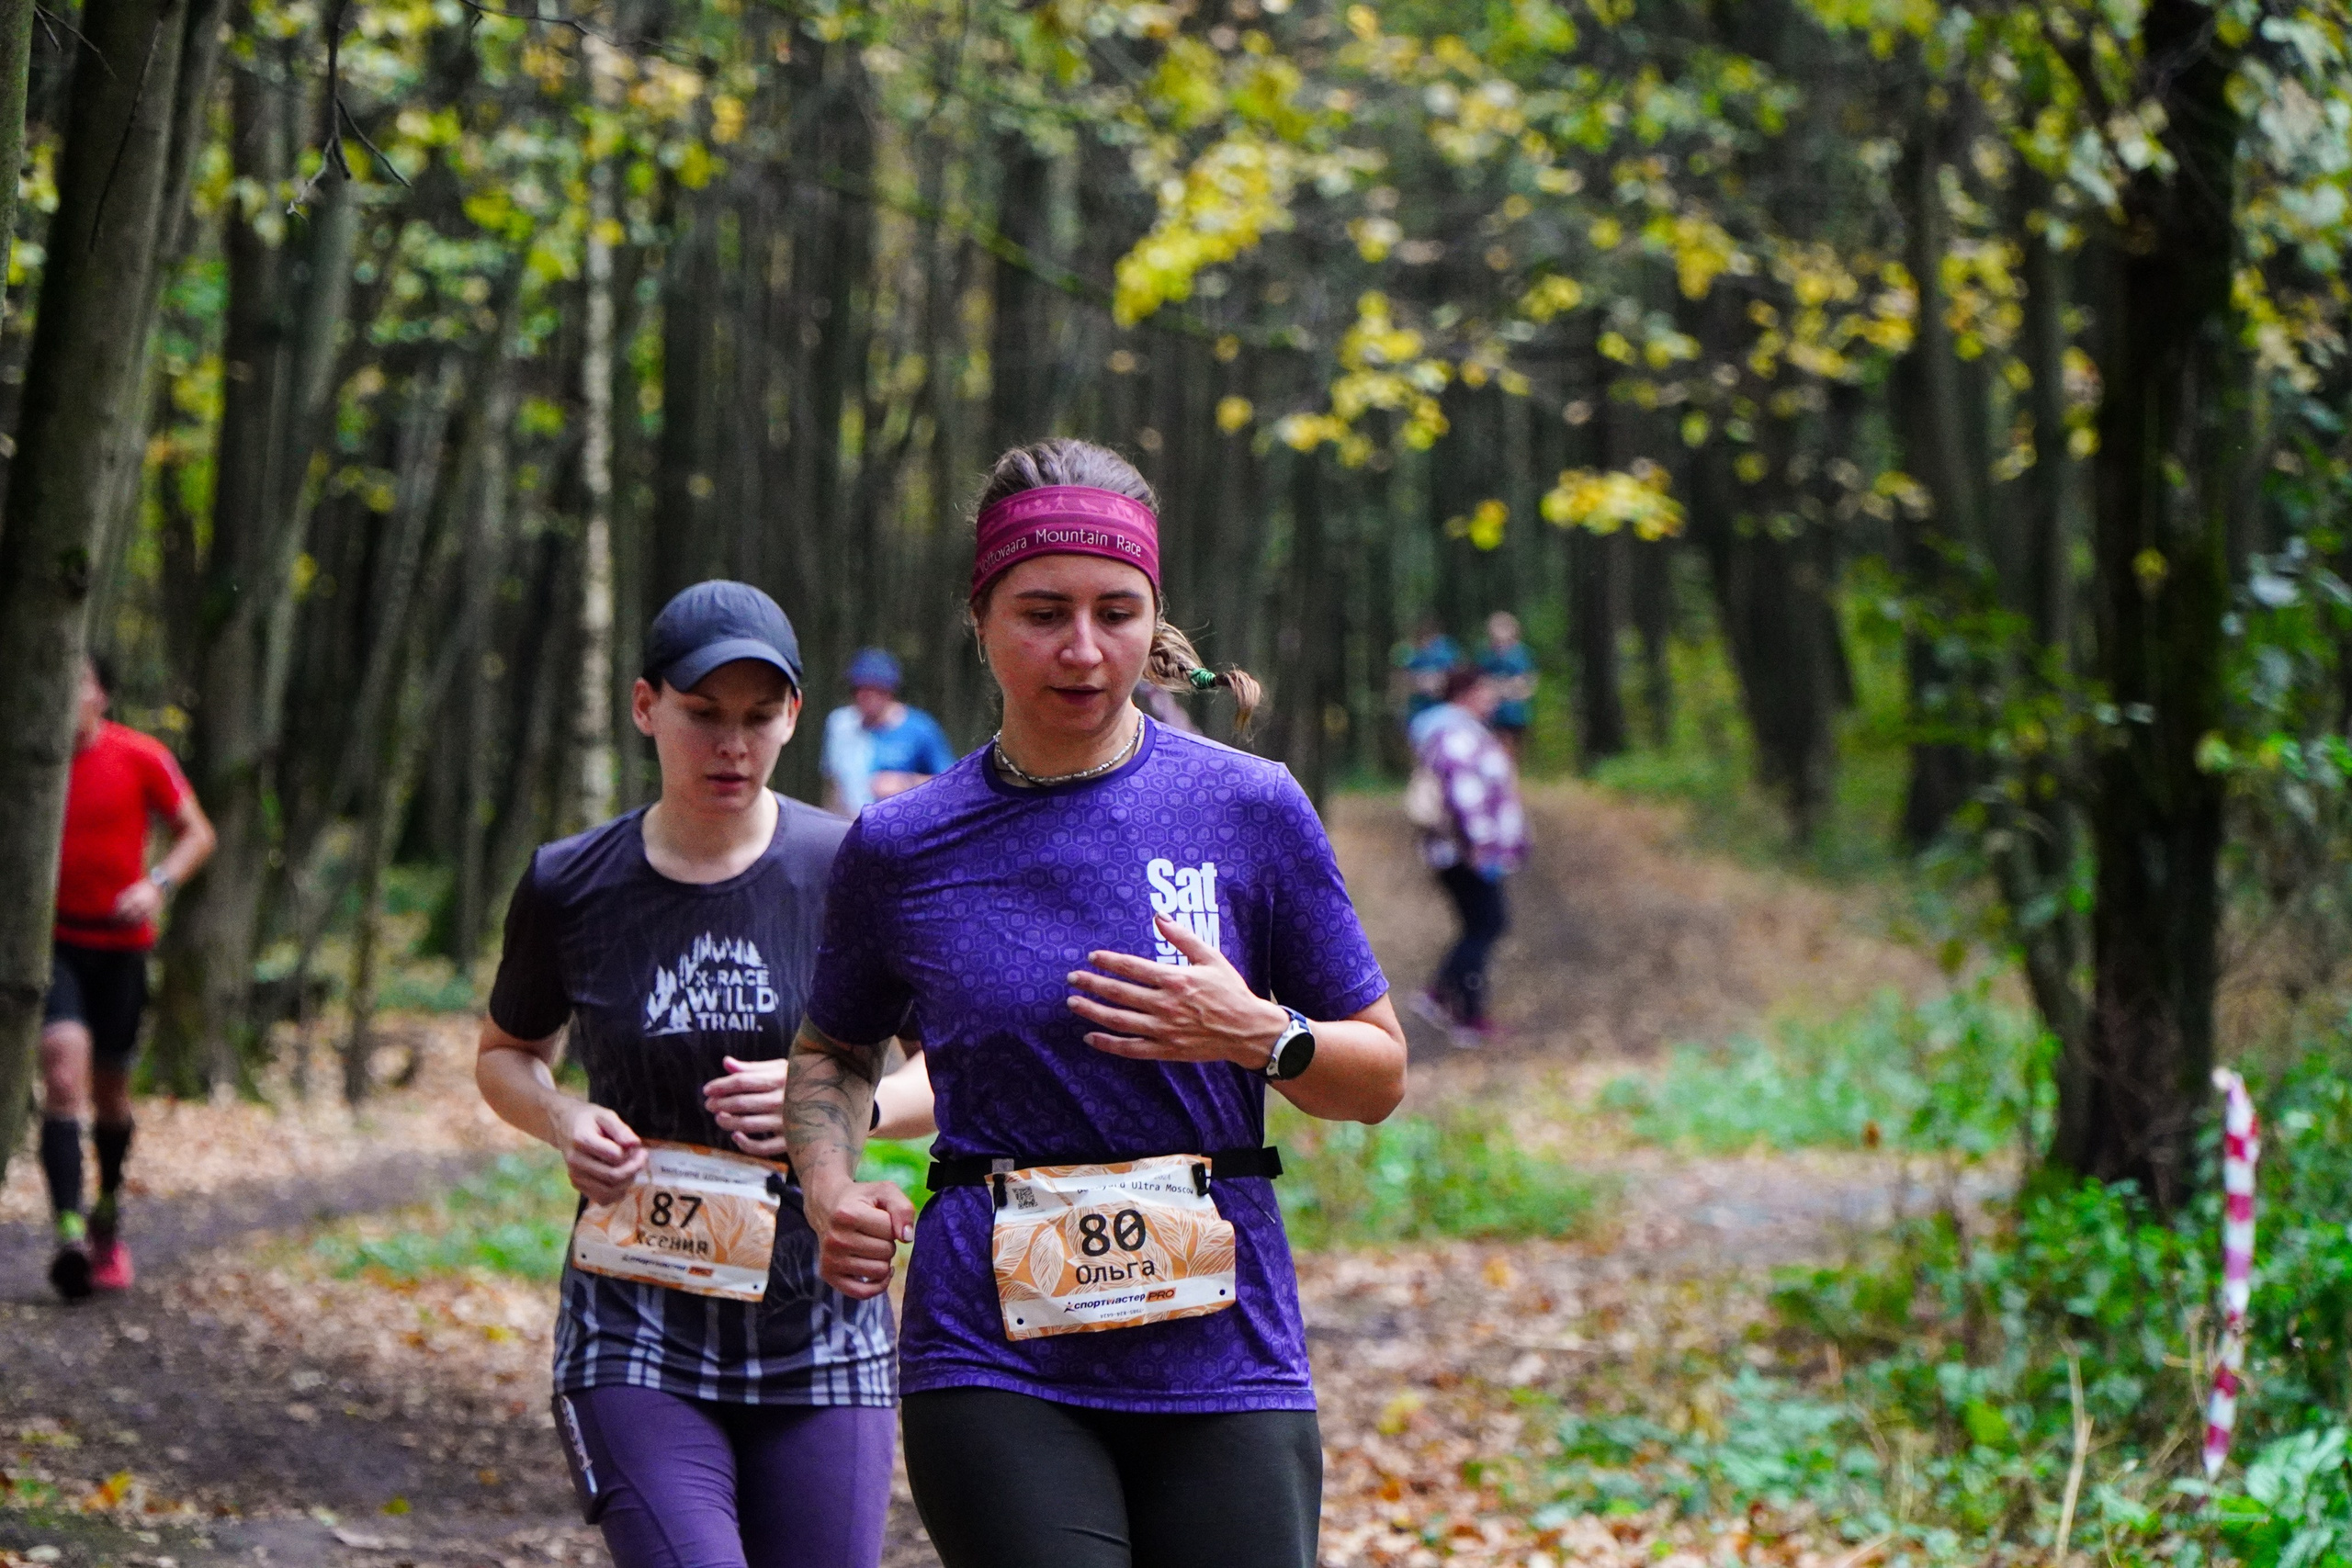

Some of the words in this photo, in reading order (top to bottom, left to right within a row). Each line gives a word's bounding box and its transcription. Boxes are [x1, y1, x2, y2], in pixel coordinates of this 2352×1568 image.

[1035, 528, 1108, 546] Mountain
[1116, 535, 1141, 558] Race
[1147, 858, 1219, 913] Sat
[695, 969, 769, 987] X-RACE
[686, 986, 777, 1013] WILD
[1132, 1181, 1160, 1191] Ultra
[650, 1191, 702, 1228] 87
[1079, 1209, 1147, 1258] 80
[1076, 1259, 1156, 1285] Ольга
[1147, 1289, 1175, 1302] PRO
